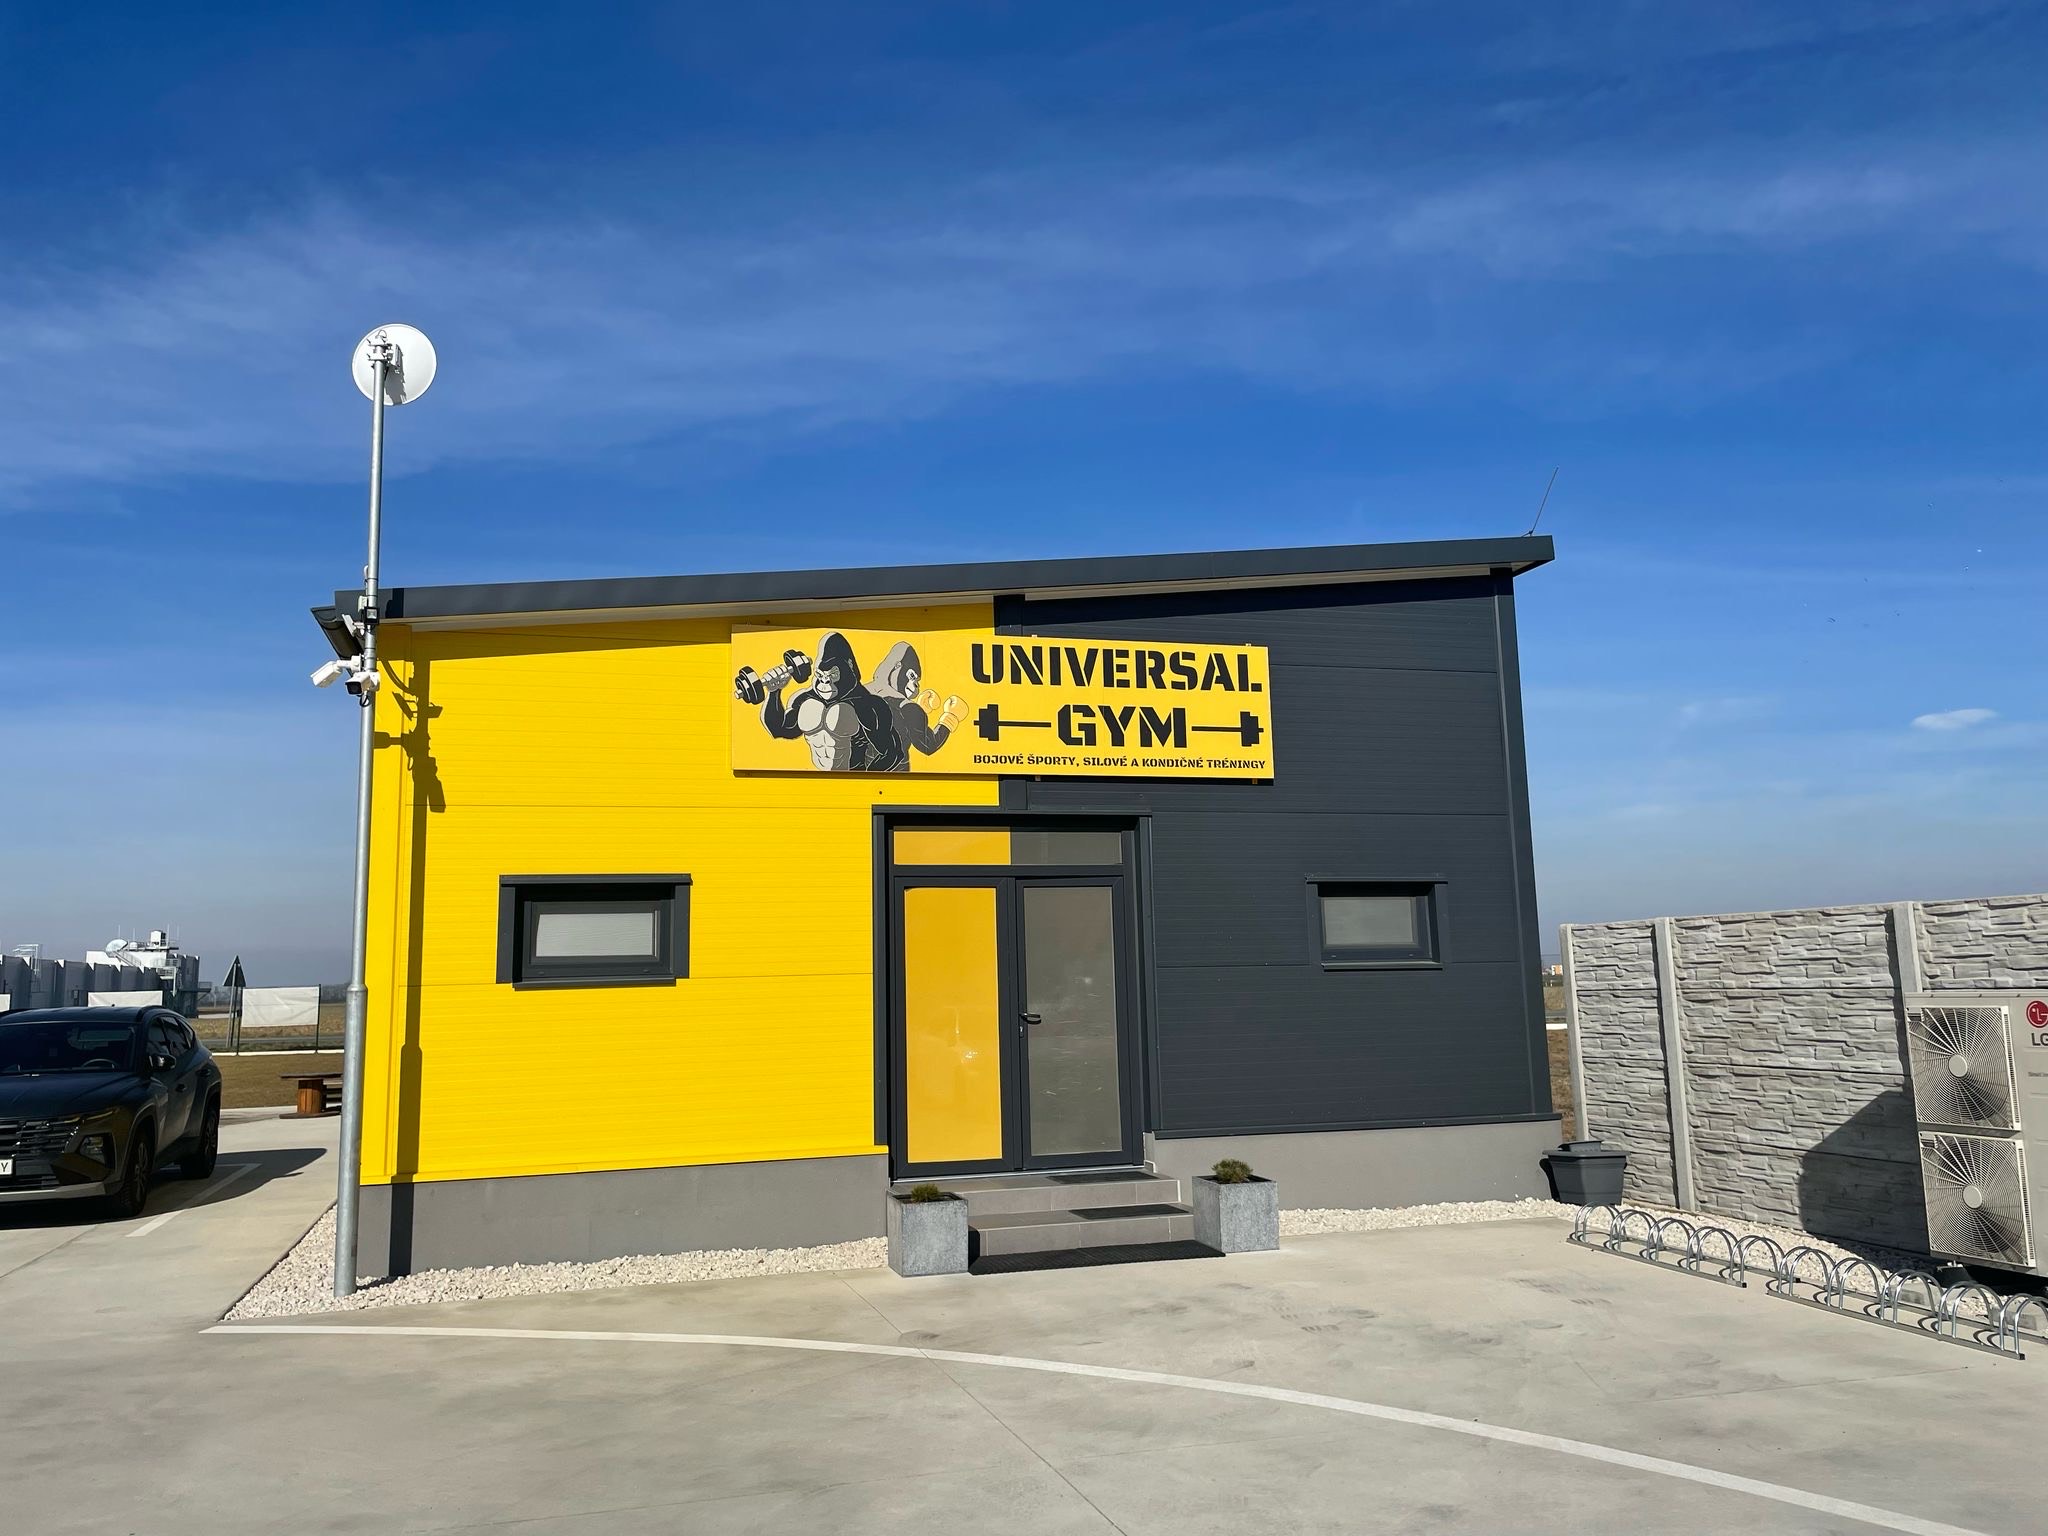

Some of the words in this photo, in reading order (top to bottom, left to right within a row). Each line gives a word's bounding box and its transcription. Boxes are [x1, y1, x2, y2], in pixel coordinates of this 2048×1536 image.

[971, 643, 1263, 692] UNIVERSAL
[1057, 703, 1188, 748] GYM
[973, 753, 1024, 765] BOJOVÉ
[1027, 754, 1080, 767] ŠPORTY,
[1083, 755, 1128, 767] SILOVÉ
[1130, 757, 1139, 767] A
[1142, 757, 1204, 768] KONDIČNÉ
[1206, 757, 1266, 769] TRÉNINGY
[2031, 1033, 2048, 1046] LG
